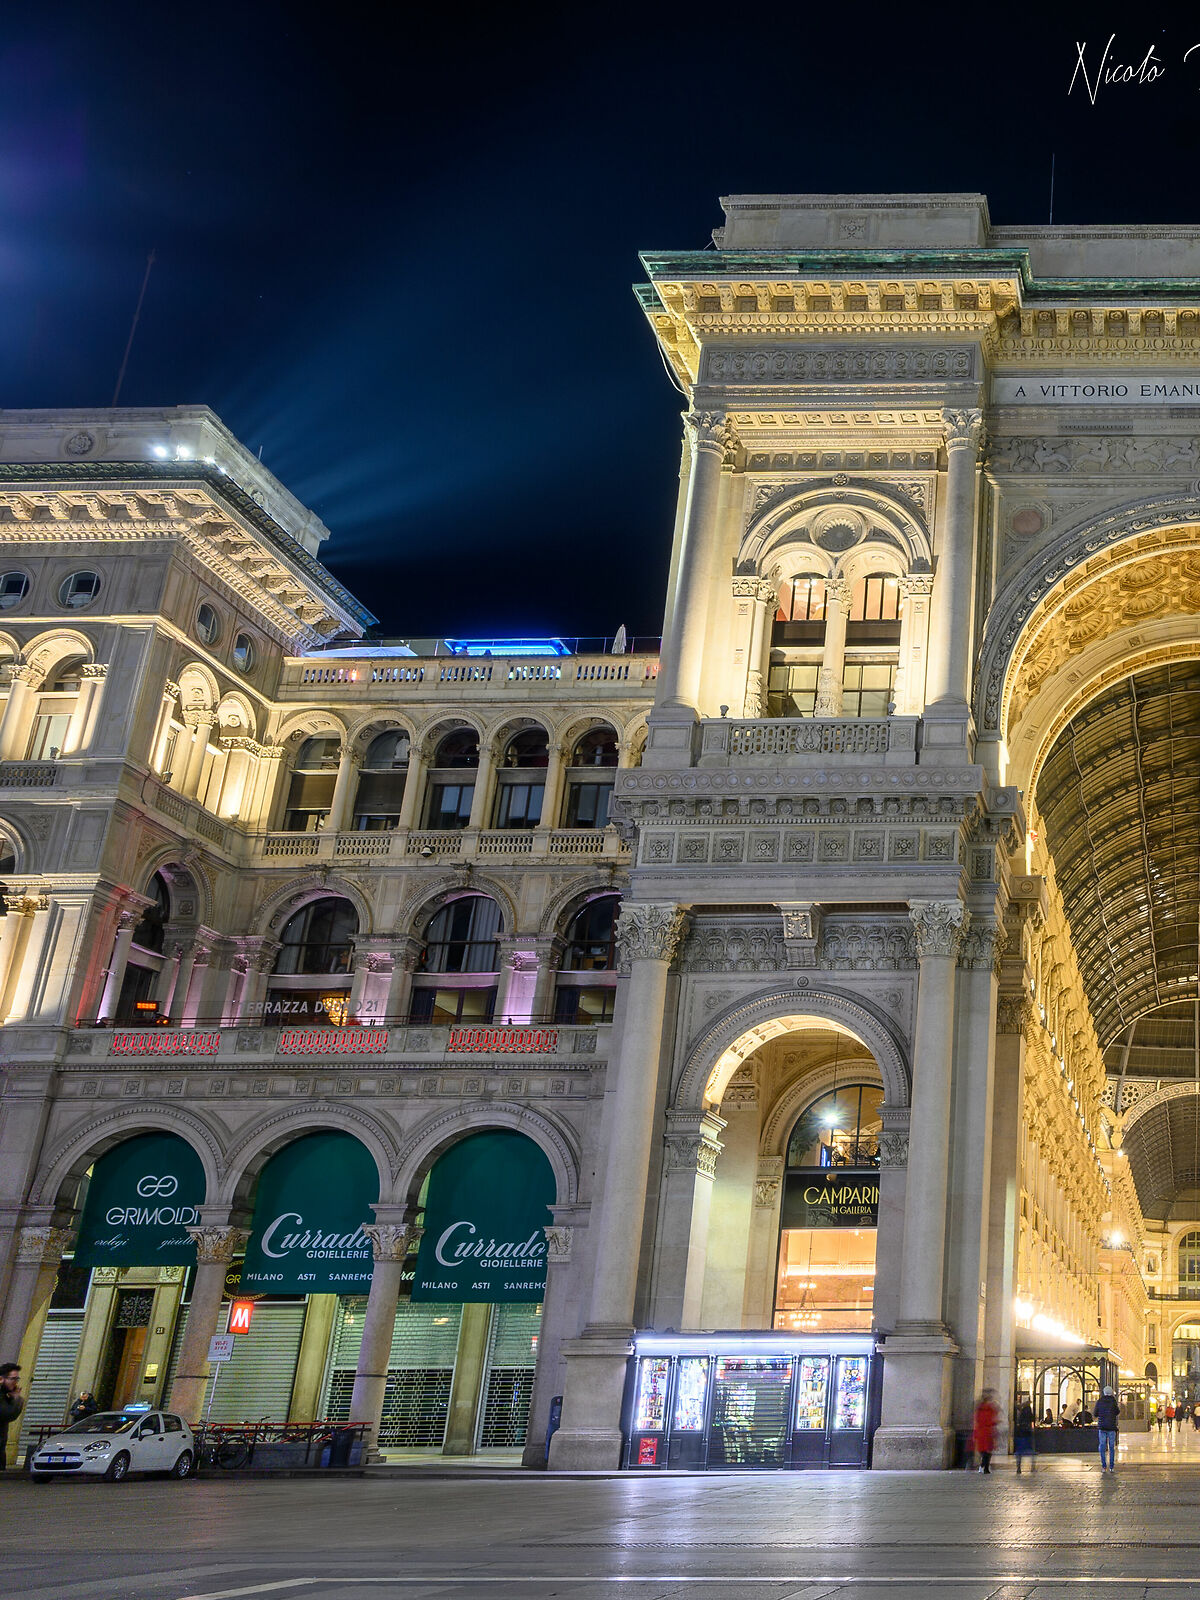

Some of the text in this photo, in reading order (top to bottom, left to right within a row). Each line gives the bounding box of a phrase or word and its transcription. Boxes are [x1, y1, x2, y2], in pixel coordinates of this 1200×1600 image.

[1015, 385, 1027, 397] A
[1039, 384, 1128, 397] VITTORIO
[366, 1000, 378, 1012] 21
[105, 1206, 199, 1225] GRIMOLDI
[840, 1206, 872, 1214] GALLERIA
[261, 1212, 372, 1259] Currado
[435, 1221, 546, 1267] Currado
[306, 1250, 369, 1259] GIOIELLERIE
[479, 1259, 543, 1268] GIOIELLERIE
[246, 1273, 373, 1281] MILANO ASTI SANREMO
[421, 1281, 458, 1289] MILANO
[503, 1282, 547, 1290] SANREMO
[231, 1308, 249, 1328] M
